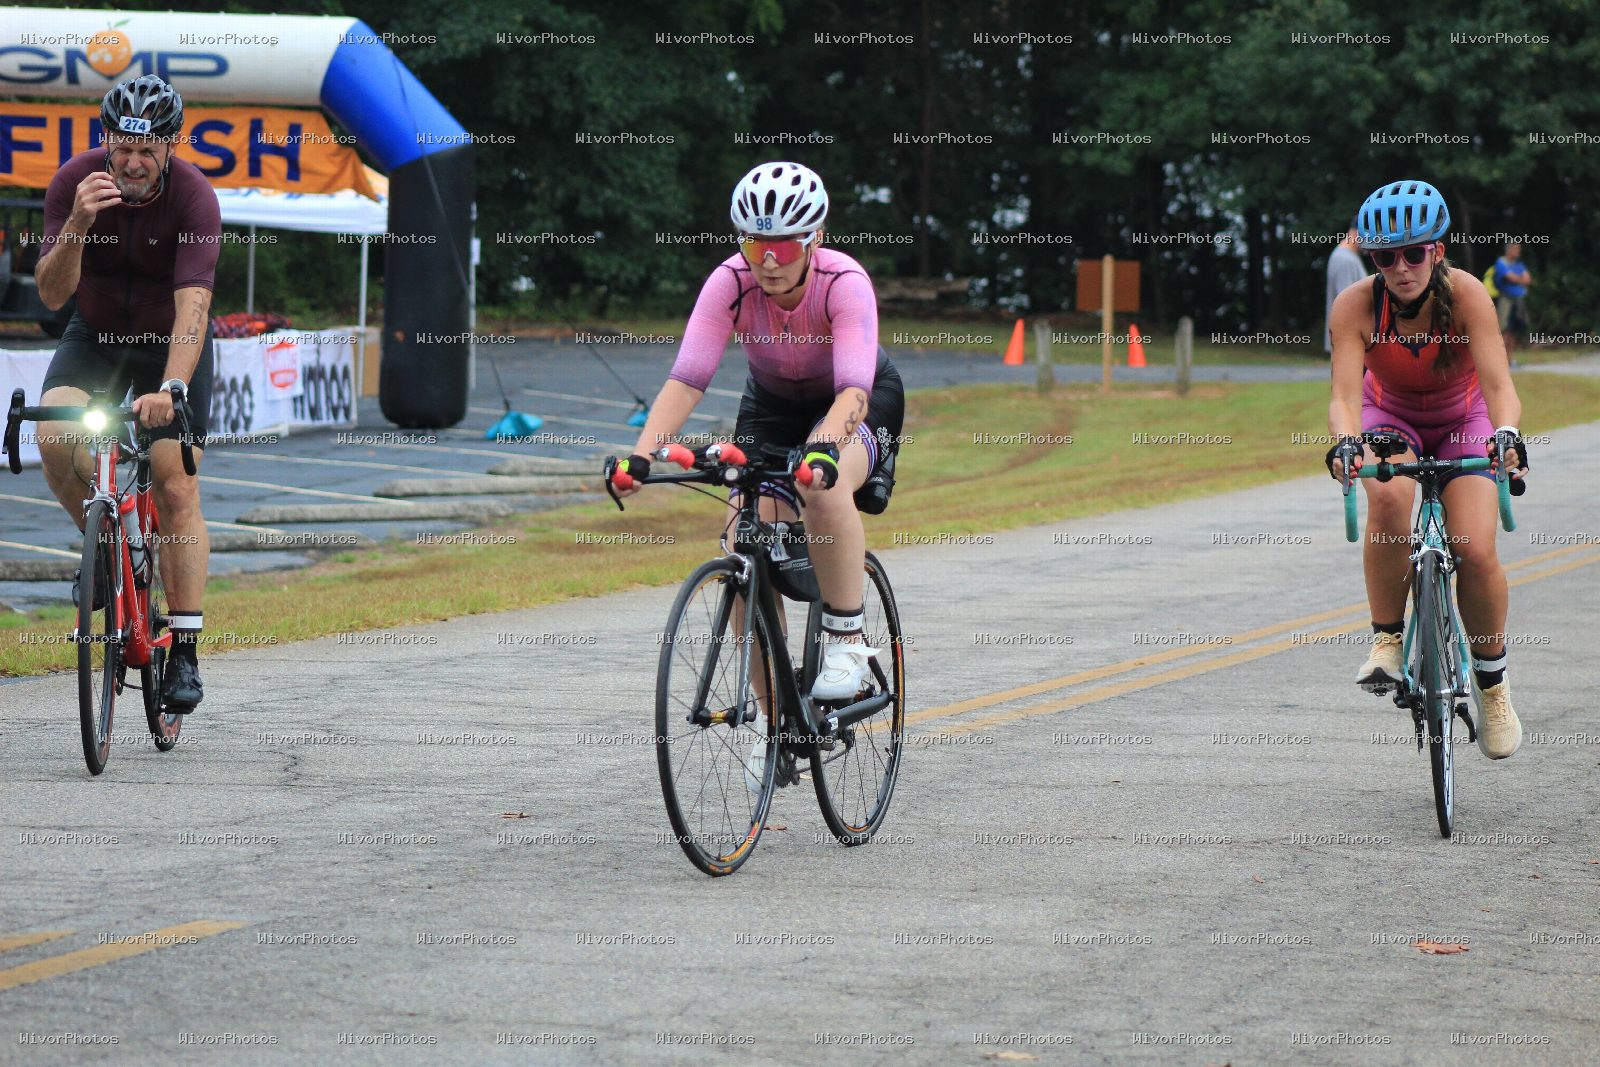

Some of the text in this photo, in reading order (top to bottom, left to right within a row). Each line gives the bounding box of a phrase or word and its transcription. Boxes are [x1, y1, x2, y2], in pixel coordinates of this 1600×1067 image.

[0, 44, 229, 87] GMP
[124, 118, 147, 133] 274
[0, 113, 303, 182] FISH
[756, 217, 773, 231] 98
